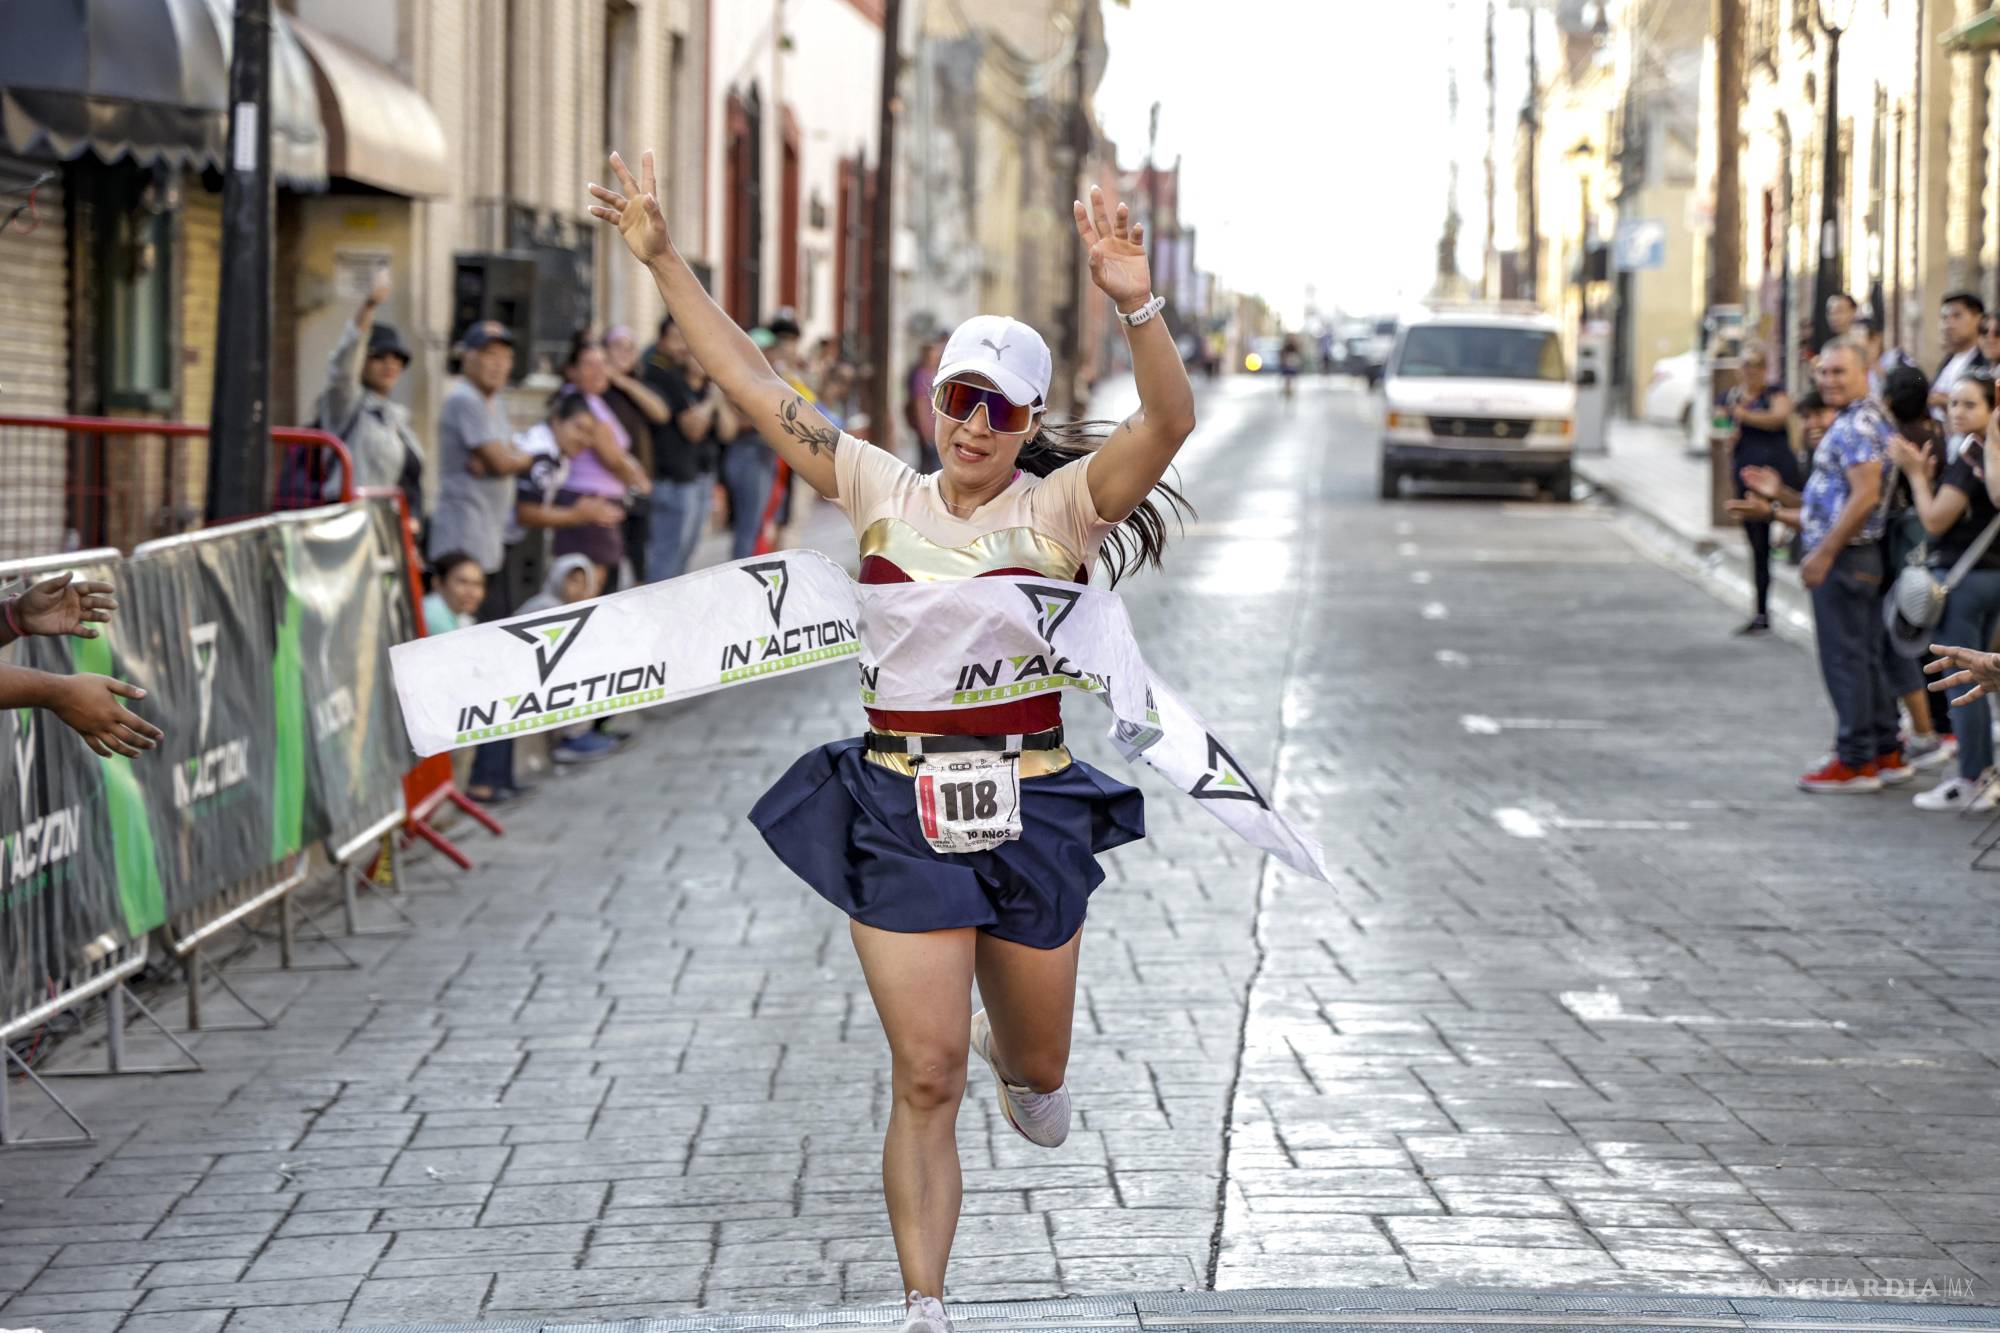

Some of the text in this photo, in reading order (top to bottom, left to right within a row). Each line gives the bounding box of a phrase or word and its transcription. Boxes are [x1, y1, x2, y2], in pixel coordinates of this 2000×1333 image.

[720, 618, 857, 670] IN ACTION
[955, 659, 1002, 691] IN
[964, 677, 1049, 703] EVENTOS
[457, 661, 666, 732] IN ACTION
[940, 780, 998, 821] 118
[967, 828, 1011, 840] 10 AÑOS
